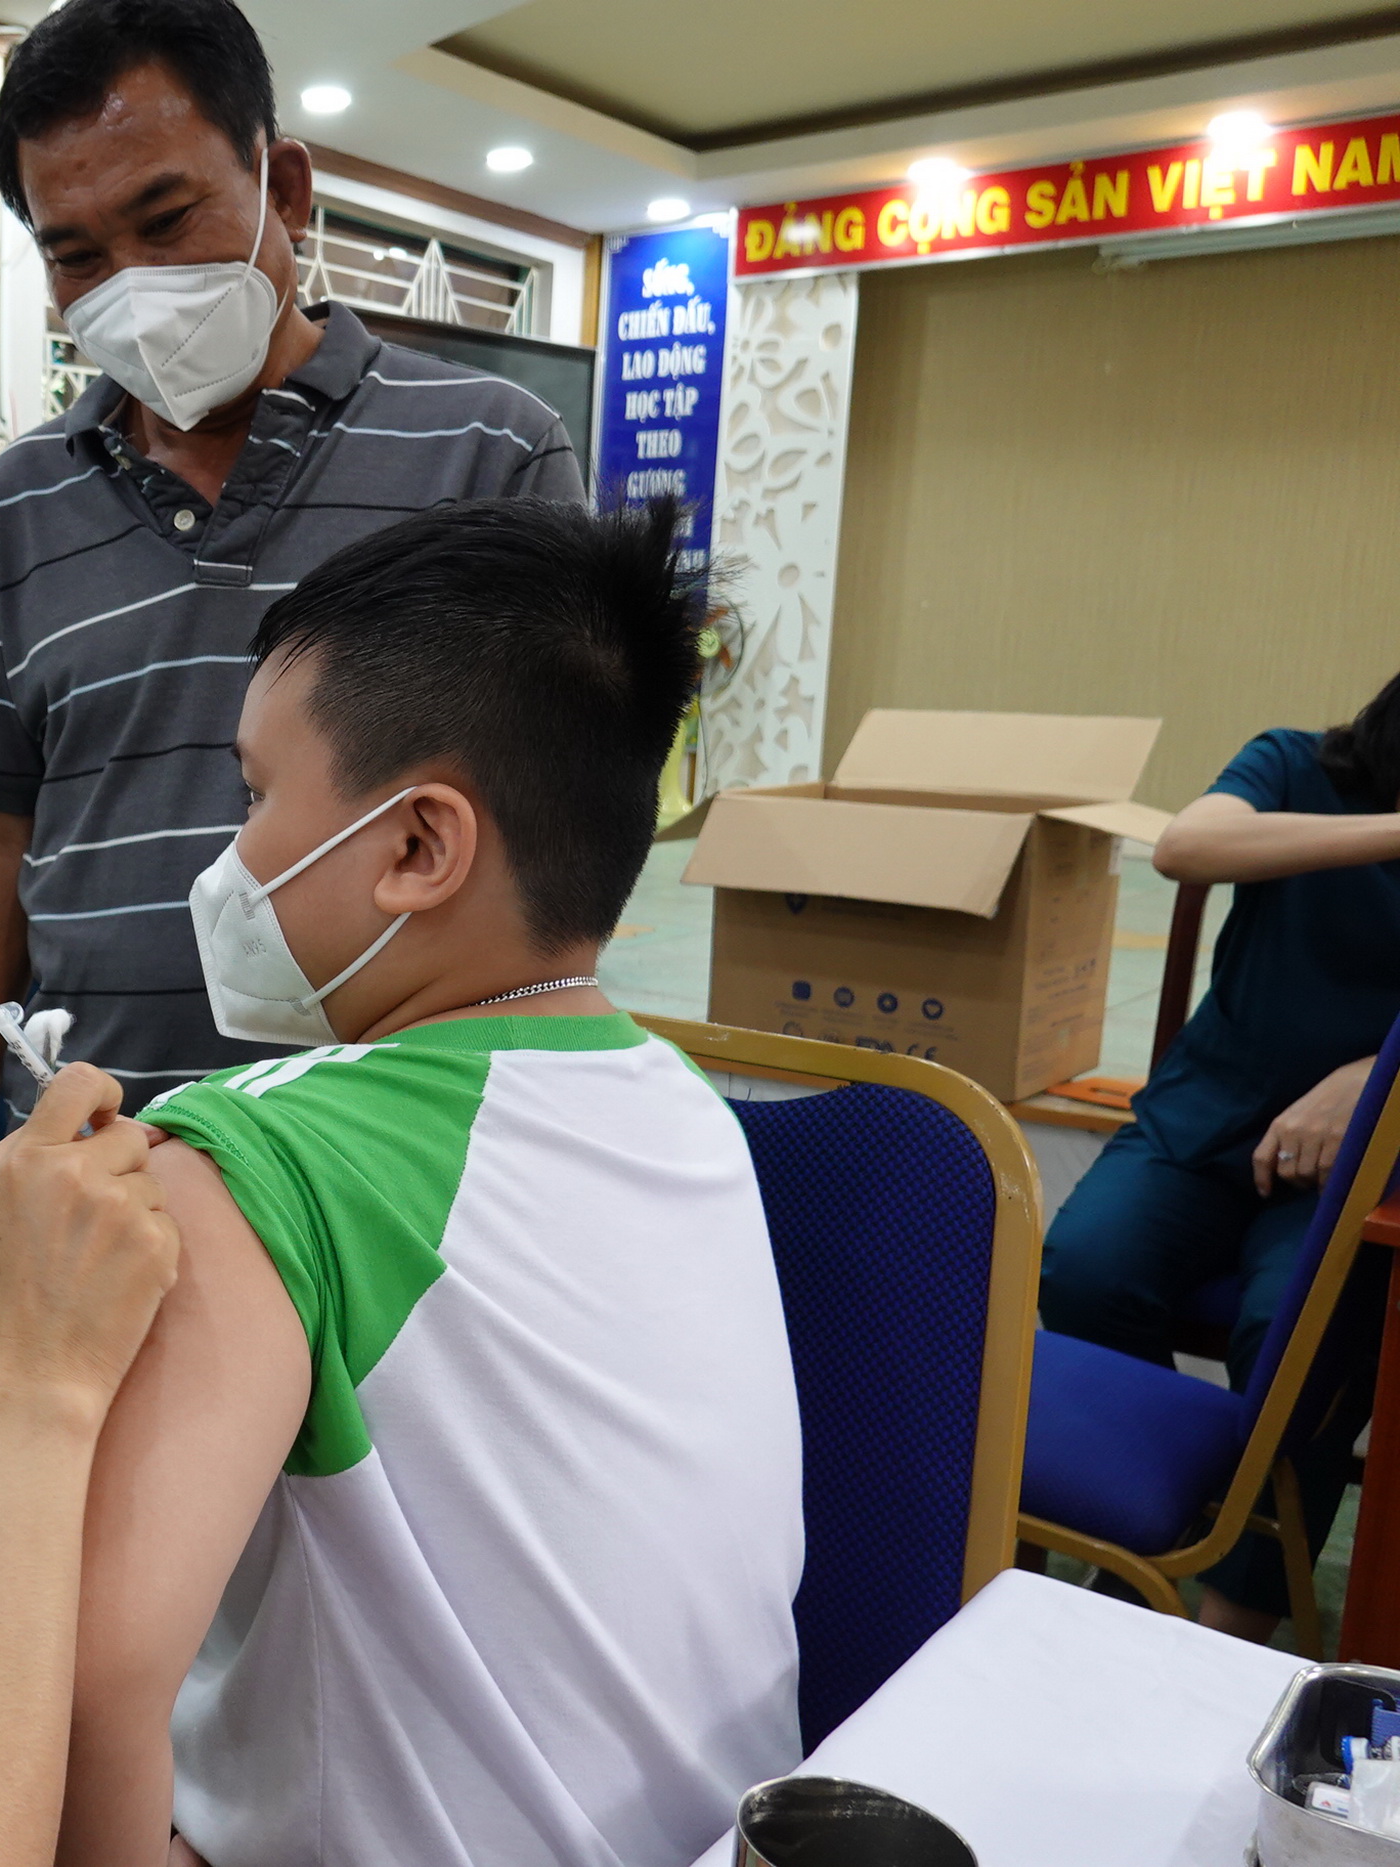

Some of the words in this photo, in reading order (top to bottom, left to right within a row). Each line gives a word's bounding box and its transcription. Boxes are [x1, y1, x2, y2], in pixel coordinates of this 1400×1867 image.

[744, 201, 866, 263] ĐẢNG
[1024, 161, 1130, 229] SẢN
[618, 300, 671, 341] CHIẾN
[622, 350, 655, 380] LAO
[657, 341, 707, 380] ĐỘNG
[625, 389, 661, 424] HỌC
[663, 382, 699, 421] TẬP
[636, 428, 683, 459] THEO
